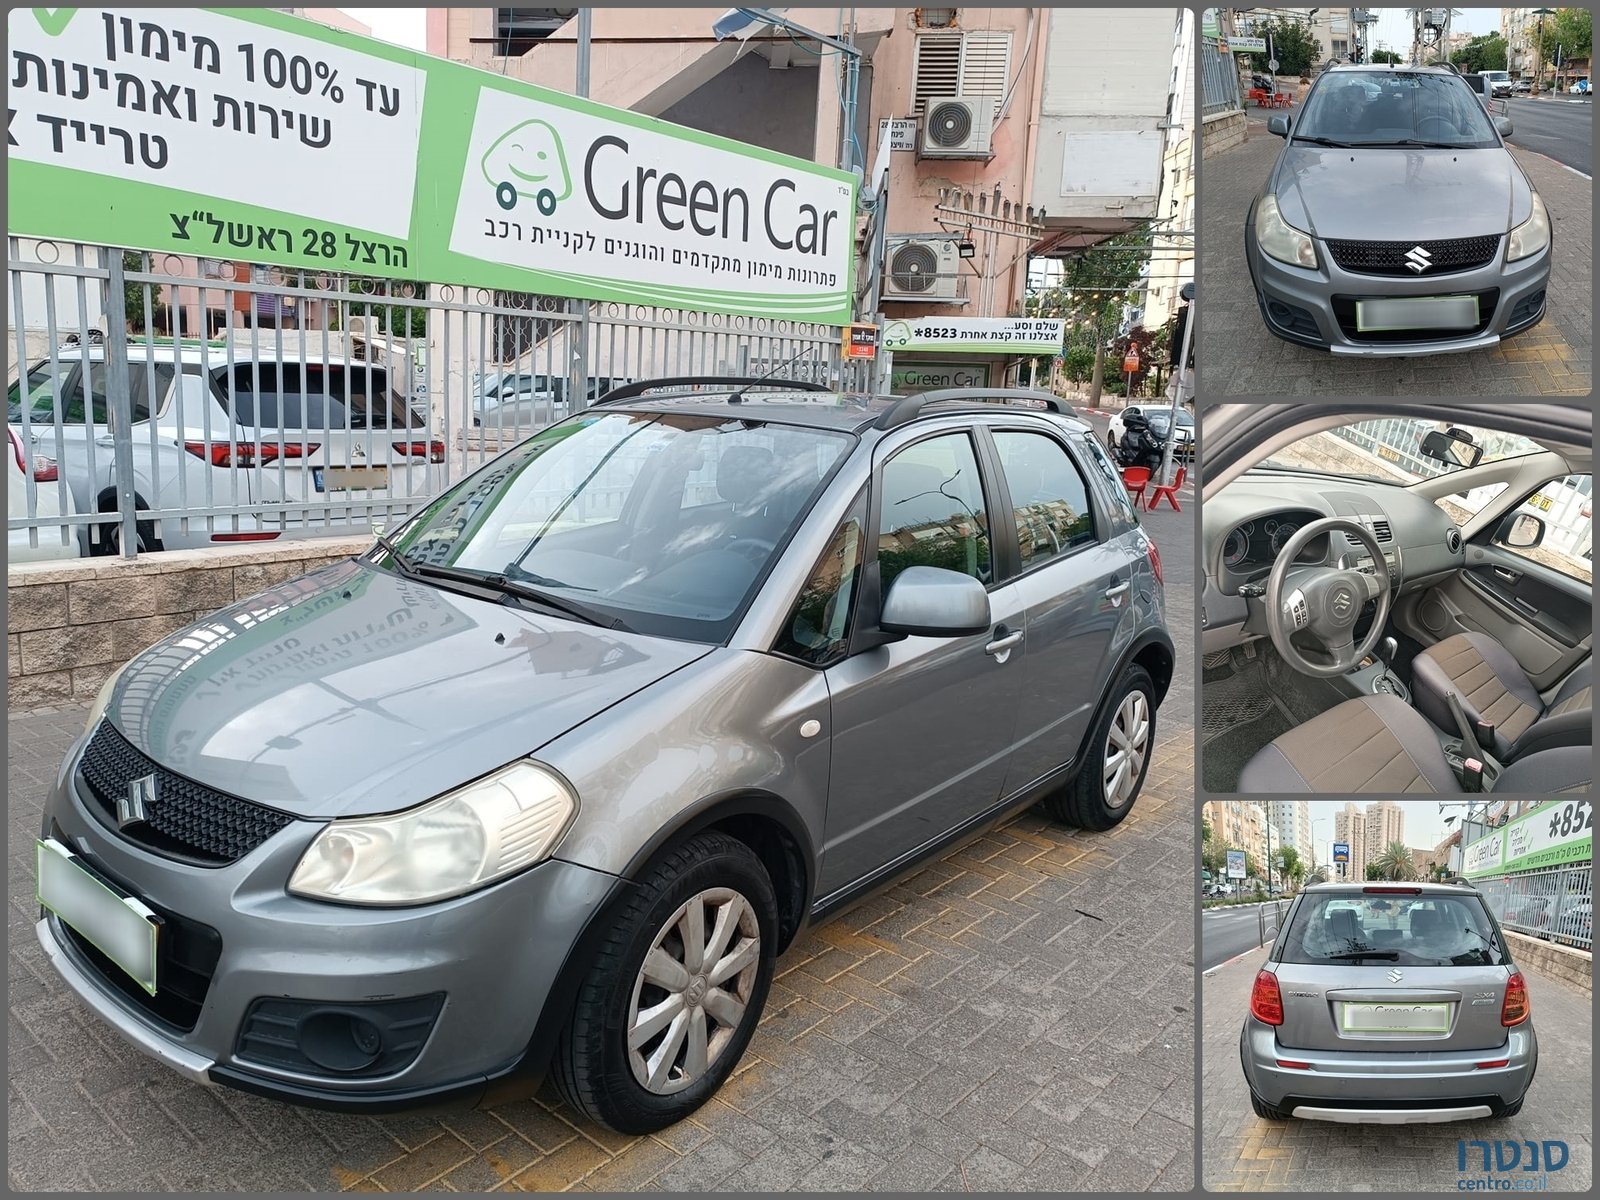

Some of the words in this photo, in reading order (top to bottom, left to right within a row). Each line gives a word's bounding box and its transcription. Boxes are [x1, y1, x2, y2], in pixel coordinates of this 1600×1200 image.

[101, 12, 221, 75] מימון
[12, 50, 198, 122] ואמינות
[237, 43, 345, 104] 100%
[355, 77, 400, 117] עד
[212, 94, 332, 149] שירות
[36, 114, 169, 170] טרייד
[584, 135, 750, 242] Green
[763, 178, 839, 257] Car
[484, 217, 523, 242] רכב
[530, 225, 595, 253] לקניית
[302, 229, 336, 259] 28
[345, 233, 408, 268] הרצל
[604, 238, 665, 263] והוגנים
[672, 249, 742, 275] מתקדמים
[747, 259, 782, 280] מימון
[786, 264, 837, 287] פתרונות
[960, 331, 988, 340] אחרת
[990, 331, 1012, 342] קצת
[1014, 332, 1026, 340] זה
[1029, 331, 1058, 341] אצלנו
[1035, 321, 1058, 331] שלם
[904, 370, 950, 386] Green
[953, 372, 980, 387] Car
